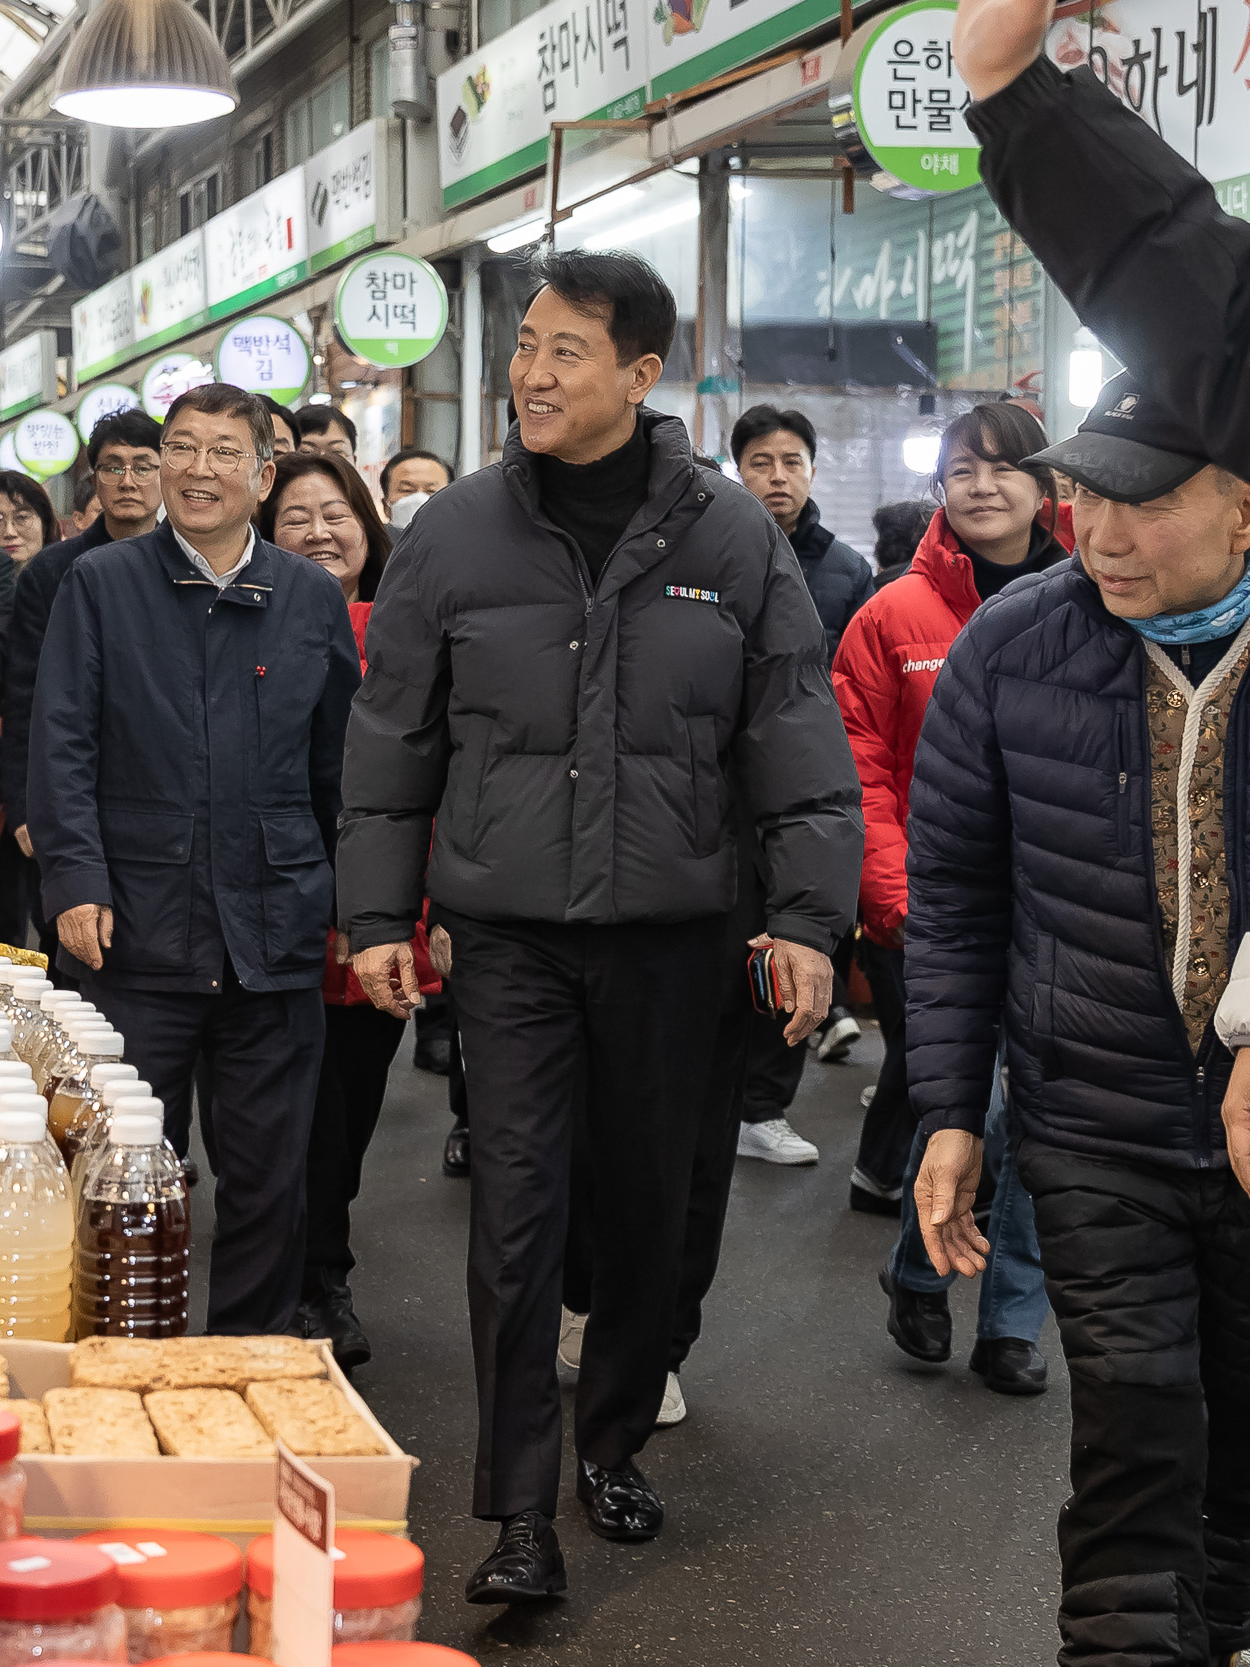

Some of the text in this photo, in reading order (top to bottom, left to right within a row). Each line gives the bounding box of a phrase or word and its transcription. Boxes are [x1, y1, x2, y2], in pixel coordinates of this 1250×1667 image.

[538, 0, 630, 114] 참마시떡
[920, 153, 960, 177] 야채
[365, 269, 419, 301] 참마
[367, 303, 417, 333] 시떡
[233, 332, 291, 357] 맥반석
[255, 359, 273, 381] 김
[665, 585, 719, 603] SEOUL MY SOUL
